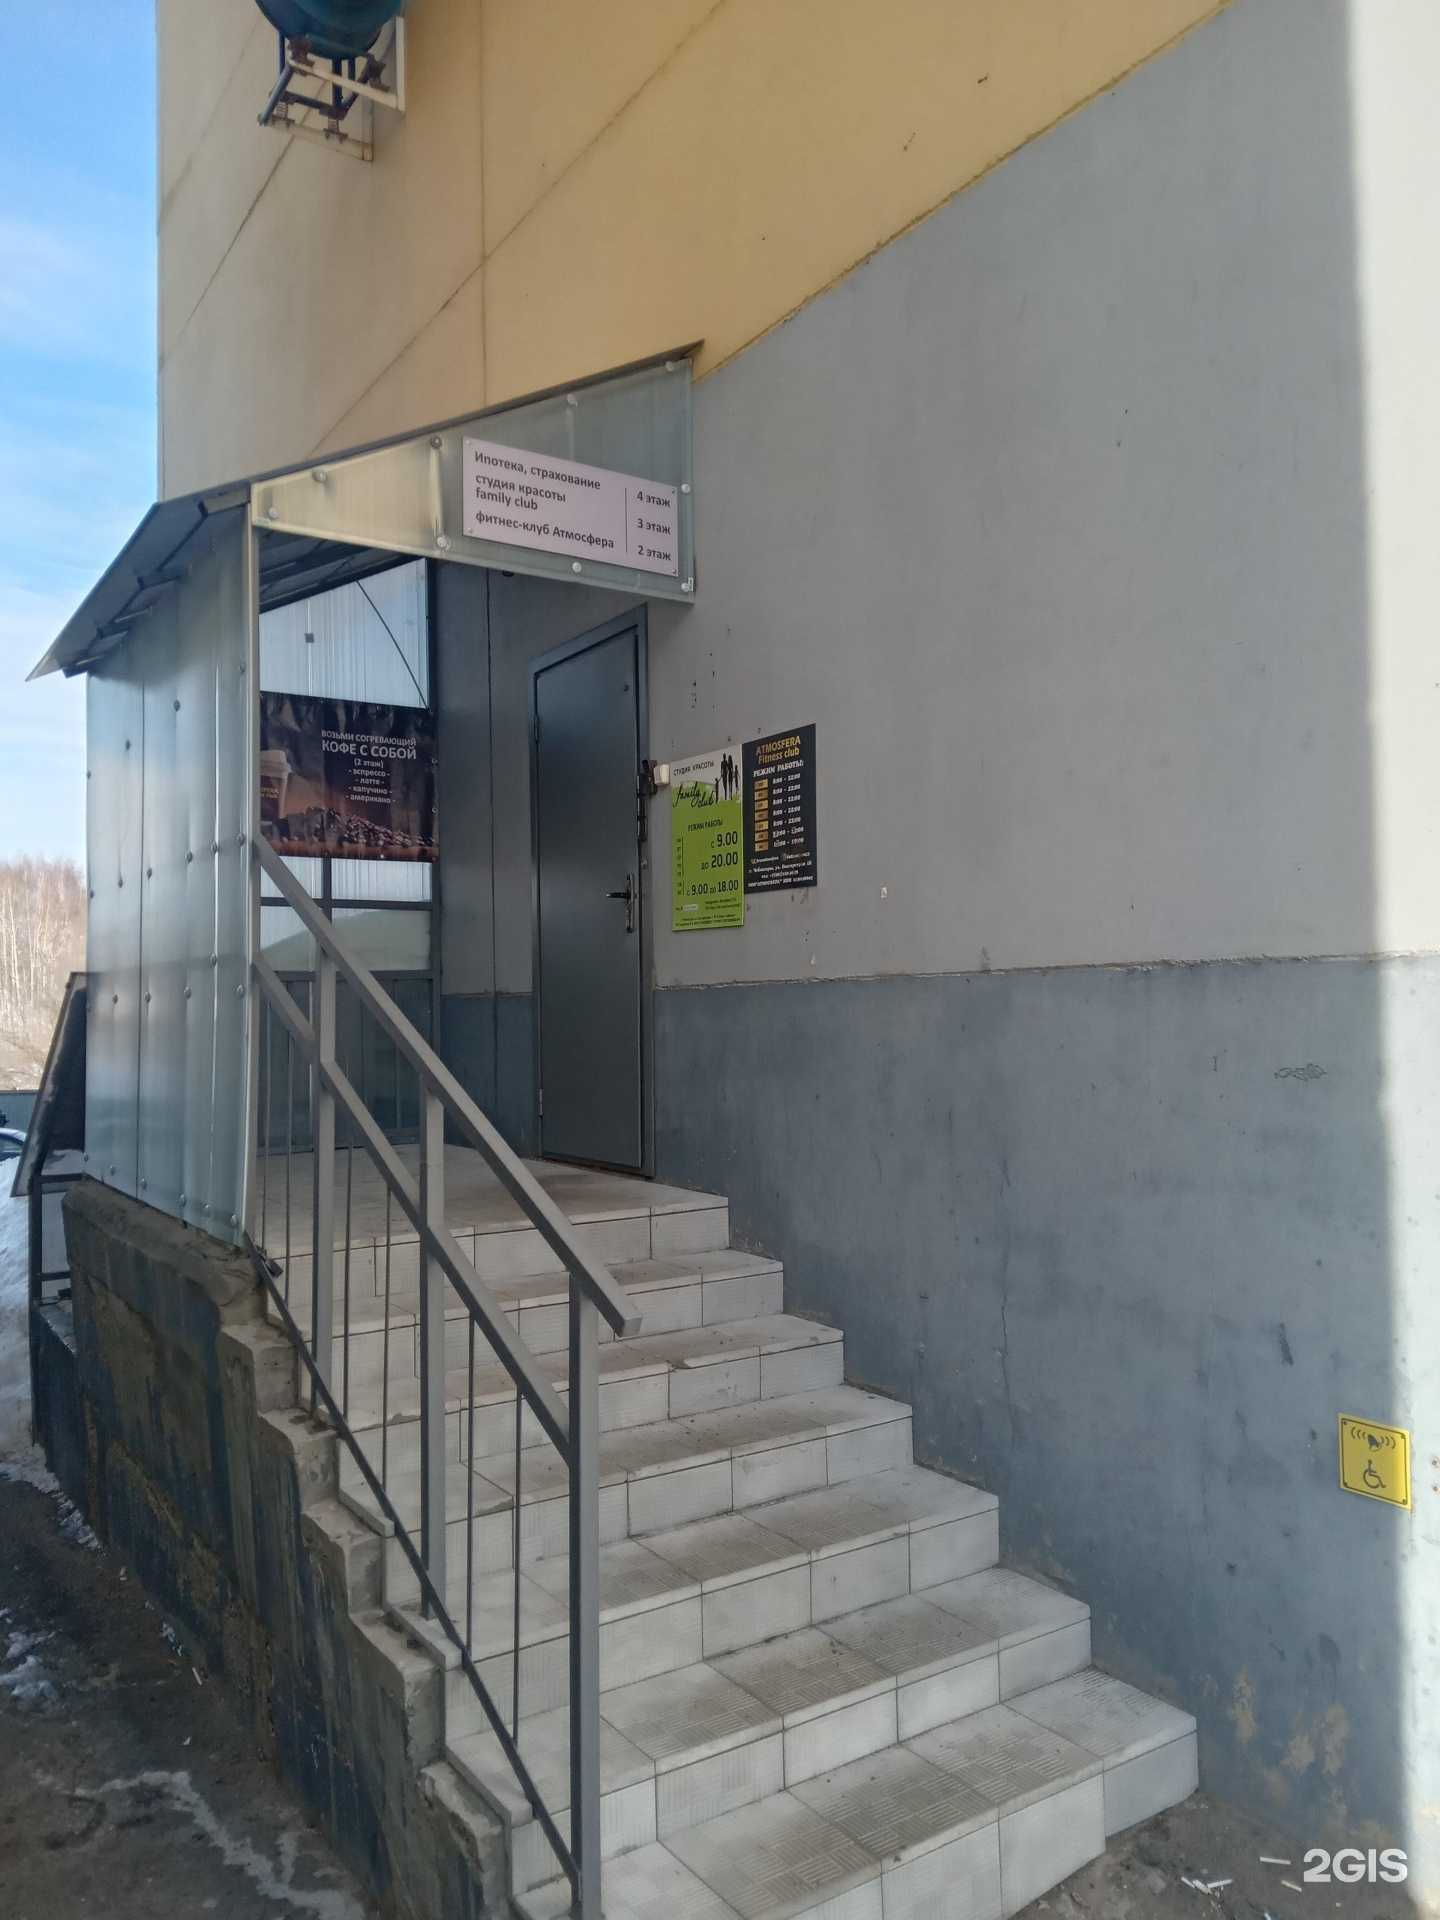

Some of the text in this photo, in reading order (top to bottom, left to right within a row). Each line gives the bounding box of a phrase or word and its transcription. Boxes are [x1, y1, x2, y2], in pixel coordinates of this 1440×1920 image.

[474, 451, 601, 490] Ипотека, страхование
[475, 475, 567, 503] студия красоты
[475, 487, 538, 511] family club
[637, 491, 671, 508] 4 этаж
[475, 510, 615, 549] фитнес-клуб Атмосфера
[637, 518, 671, 535] 3 этаж
[637, 545, 672, 561] 2 этаж
[321, 730, 417, 747] ВОЗЬМИ СОГРЕВАЮЩИЙ
[756, 735, 801, 756] ATMOSFERA
[321, 740, 417, 760] КОФЕ С СОБОЙ
[758, 746, 800, 765] Fitness club
[353, 769, 386, 778] эспрессо
[673, 760, 714, 776] СТУДИЯ КРАСОТЫ
[717, 831, 738, 847] 9.00
[711, 852, 738, 868] 20.00
[691, 883, 708, 896] 9.00
[717, 880, 739, 893] 18.00
